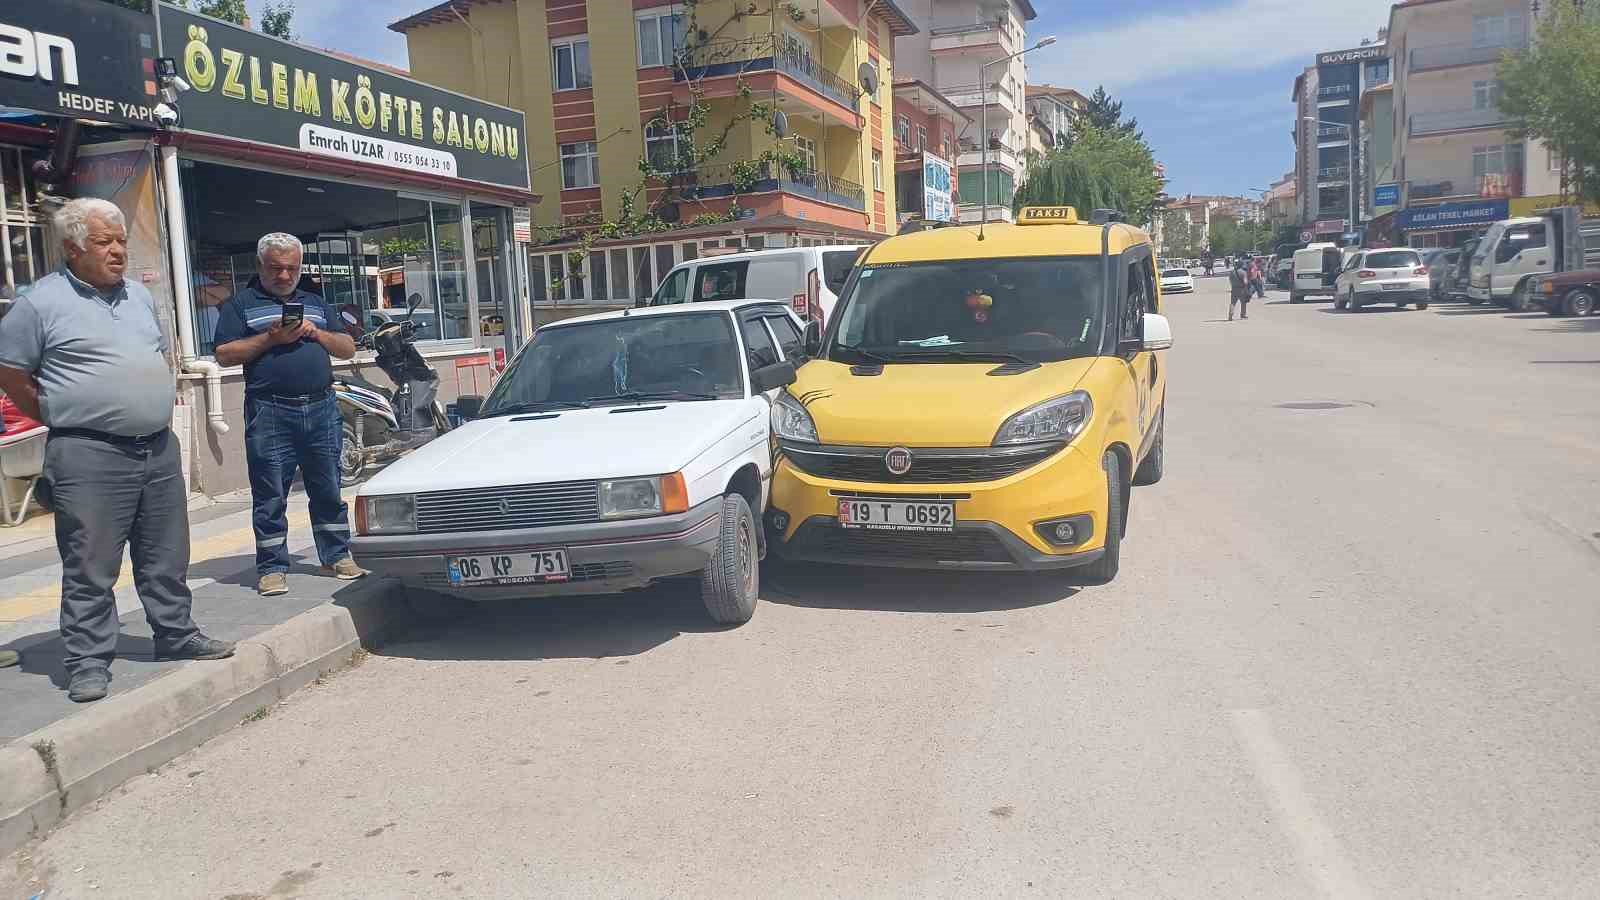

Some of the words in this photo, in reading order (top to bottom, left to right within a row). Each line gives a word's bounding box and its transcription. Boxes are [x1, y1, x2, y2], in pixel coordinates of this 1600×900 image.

[58, 91, 115, 115] HEDEF
[118, 101, 153, 122] YAPI
[183, 24, 321, 117] ÖZLEM
[331, 74, 424, 140] KÖFTE
[431, 106, 519, 160] SALONU
[308, 129, 349, 153] Emrah
[352, 139, 384, 160] UZAR
[394, 151, 413, 165] 0555
[415, 155, 429, 167] 054
[431, 157, 440, 169] 33
[443, 160, 451, 171] 10
[1463, 207, 1495, 218] MARKET
[891, 455, 907, 468] FIAT
[851, 502, 871, 521] 19
[880, 503, 892, 522] T
[905, 504, 953, 525] 0692
[459, 557, 482, 579] 06
[490, 555, 513, 577] KP
[530, 550, 566, 574] 751
